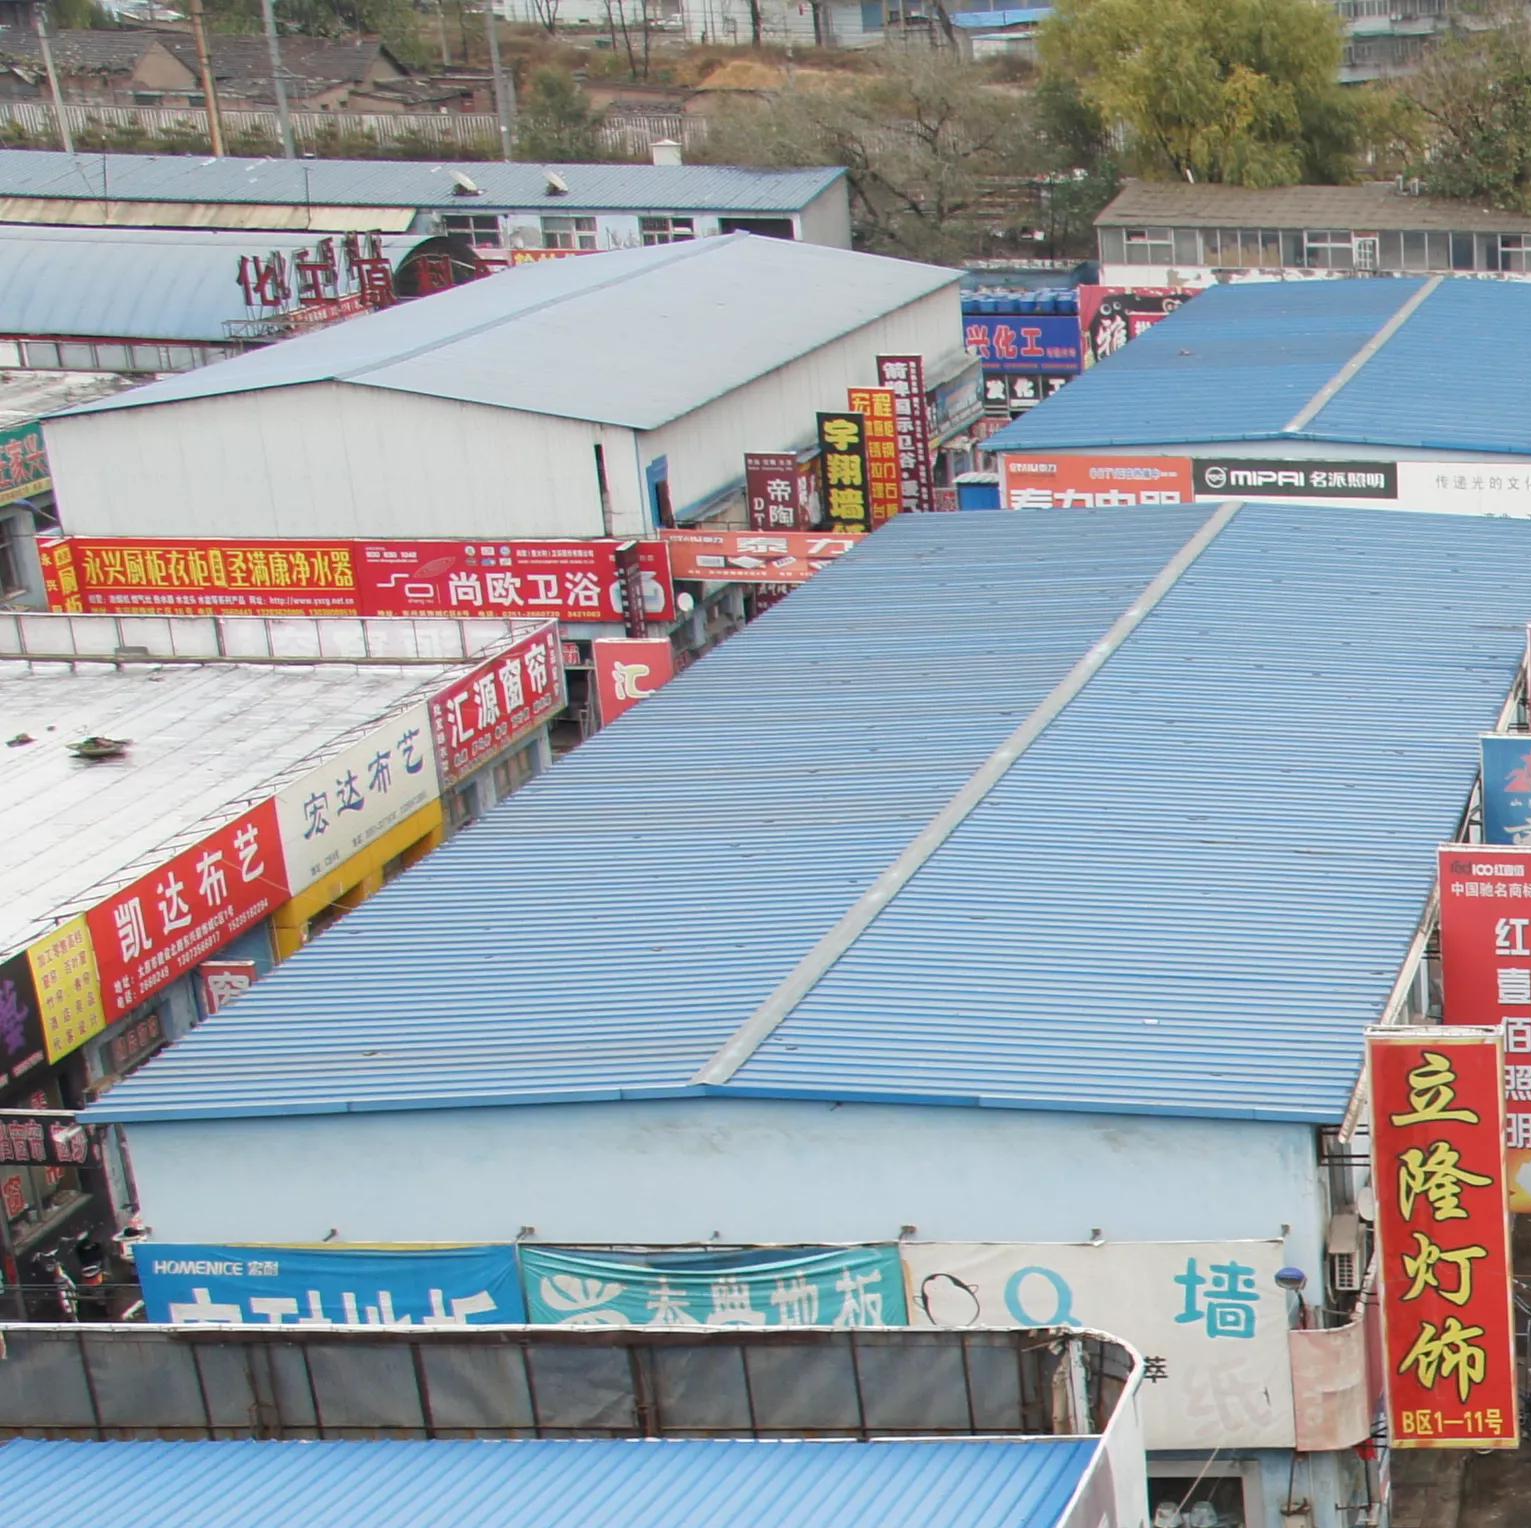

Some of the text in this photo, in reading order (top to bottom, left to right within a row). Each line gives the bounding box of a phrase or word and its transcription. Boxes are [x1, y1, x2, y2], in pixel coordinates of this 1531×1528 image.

[767, 478, 795, 528] 帝陶
[1230, 470, 1386, 489] MIPAI 名派照明
[84, 550, 354, 587] 永兴厨柜衣柜 圣满康净水器
[449, 571, 602, 607] 尚欧卫浴
[447, 643, 547, 748] 汇源窗帘
[304, 729, 424, 840] 宏达布艺
[113, 822, 267, 964] 凯达布艺
[1390, 1051, 1493, 1405] 立隆灯饰
[153, 1260, 242, 1277] HOMENICE
